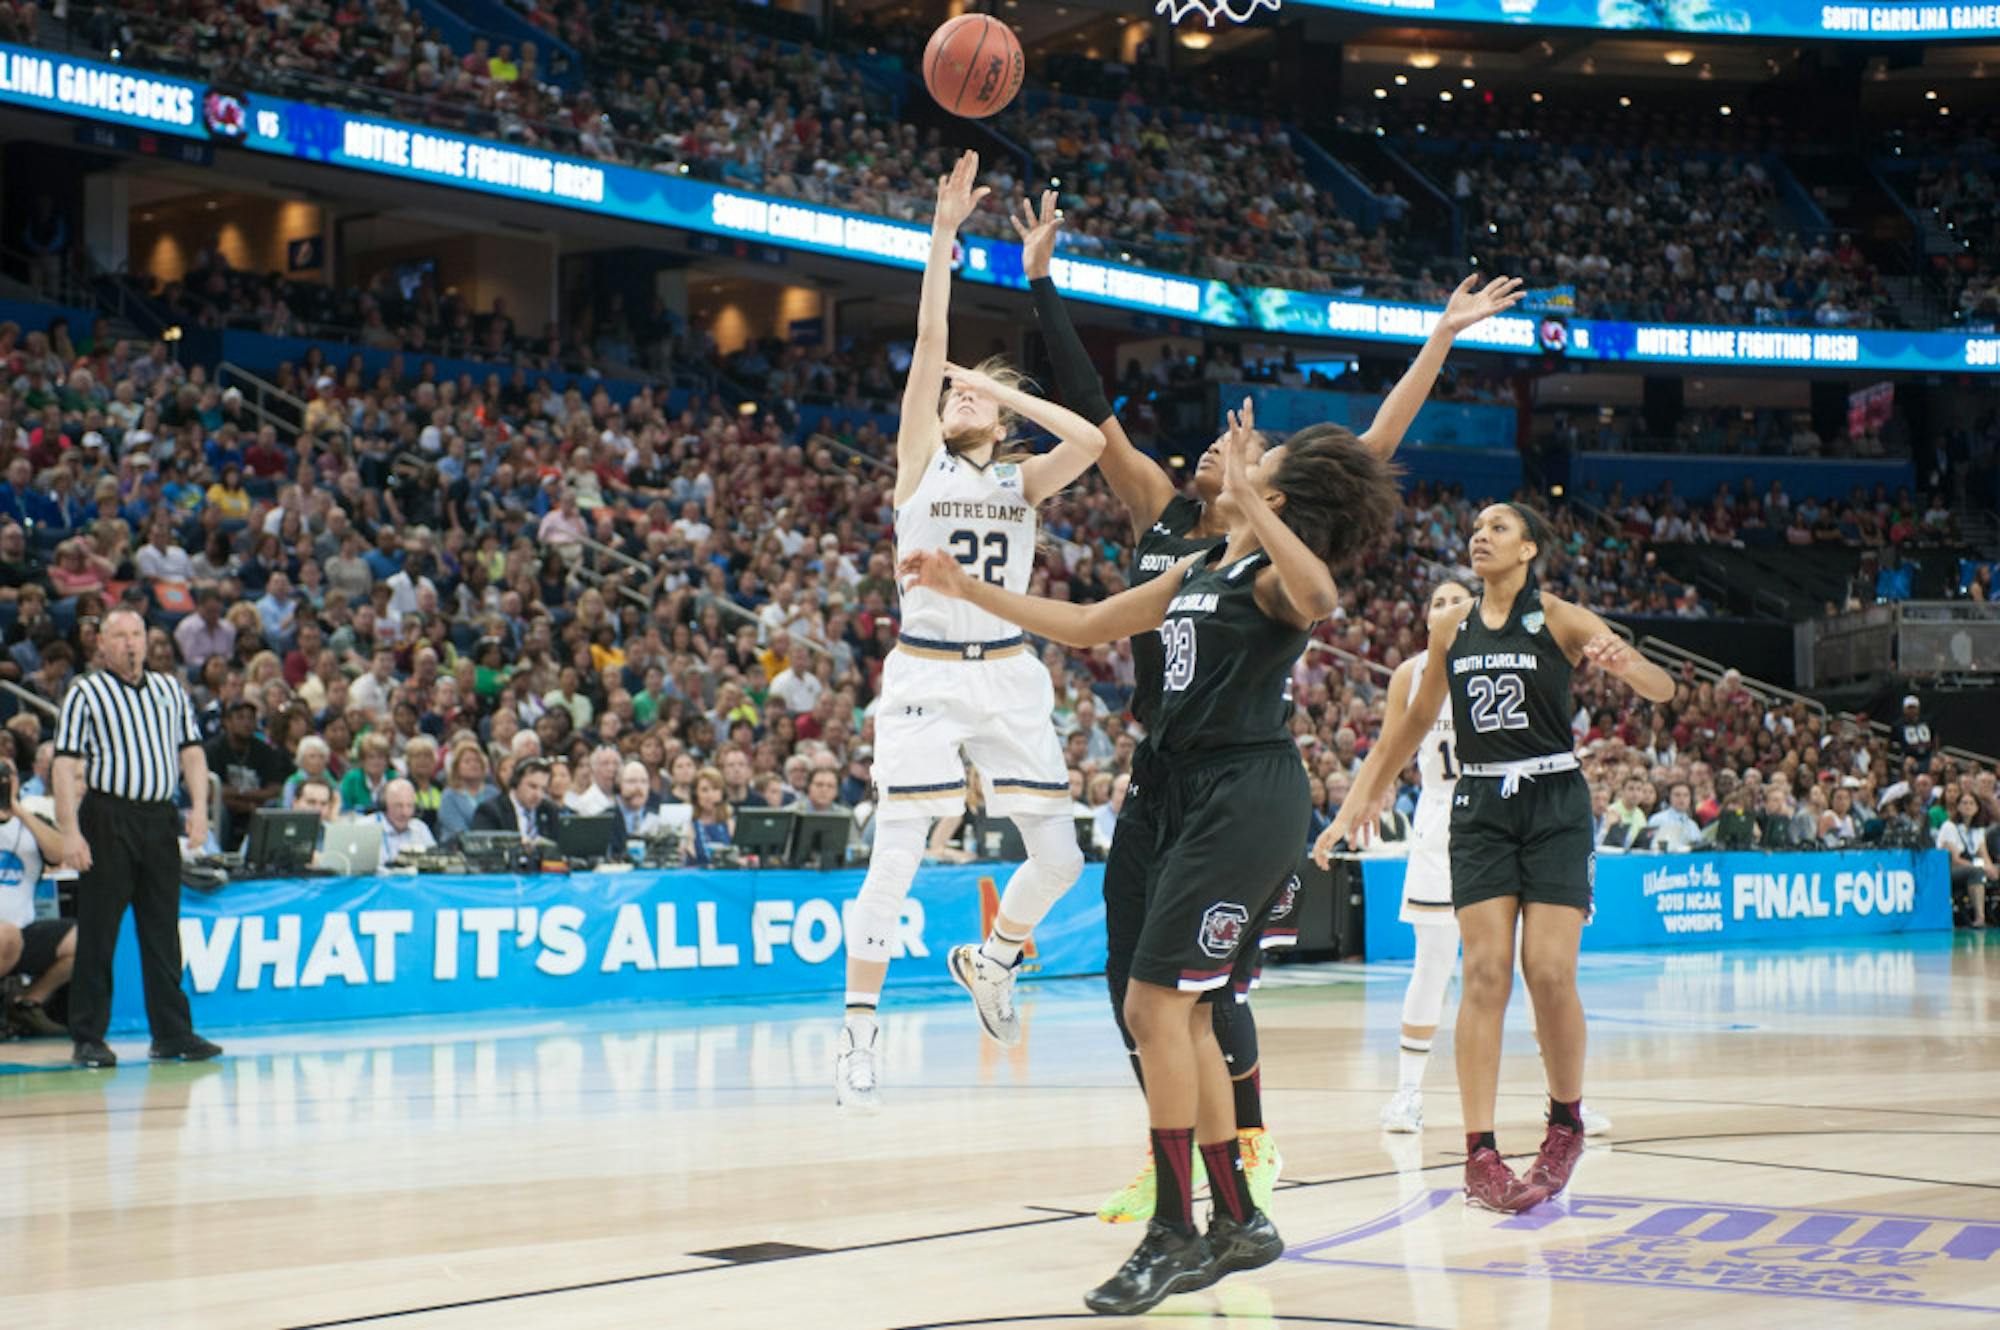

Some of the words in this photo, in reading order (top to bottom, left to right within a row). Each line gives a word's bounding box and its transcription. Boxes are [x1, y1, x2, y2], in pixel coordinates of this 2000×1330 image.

[1821, 6, 1868, 31] SOUTH
[1871, 7, 1948, 32] CAROLINA
[57, 63, 194, 127] GAMECOCKS
[344, 120, 410, 167] NOTRE
[411, 133, 465, 177] DAME
[467, 144, 552, 193] FIGHTING
[553, 161, 604, 203] IRISH
[1328, 301, 1377, 332] SOUTH
[1637, 328, 1689, 357] NOTRE
[1690, 330, 1736, 358] DAME
[1737, 331, 1812, 361] FIGHTING
[1813, 334, 1858, 362] IRISH
[1965, 338, 2000, 366] SOU
[929, 501, 984, 519] NOTRE
[987, 503, 1027, 523] DAME
[949, 529, 1009, 588] 22
[1160, 617, 1197, 691] 23
[1452, 655, 1483, 675] SOUTH
[1485, 652, 1537, 671] CAROLINA
[1466, 673, 1530, 733] 22
[1686, 891, 1722, 911] NCAA
[1732, 872, 1831, 921] FINAL
[1834, 869, 1916, 917] FOUR
[177, 909, 414, 993] WHAT
[433, 904, 588, 981] IT'S
[601, 900, 740, 972] ALL
[751, 898, 931, 966] FOR
[1663, 912, 1723, 933] WOMEN'S
